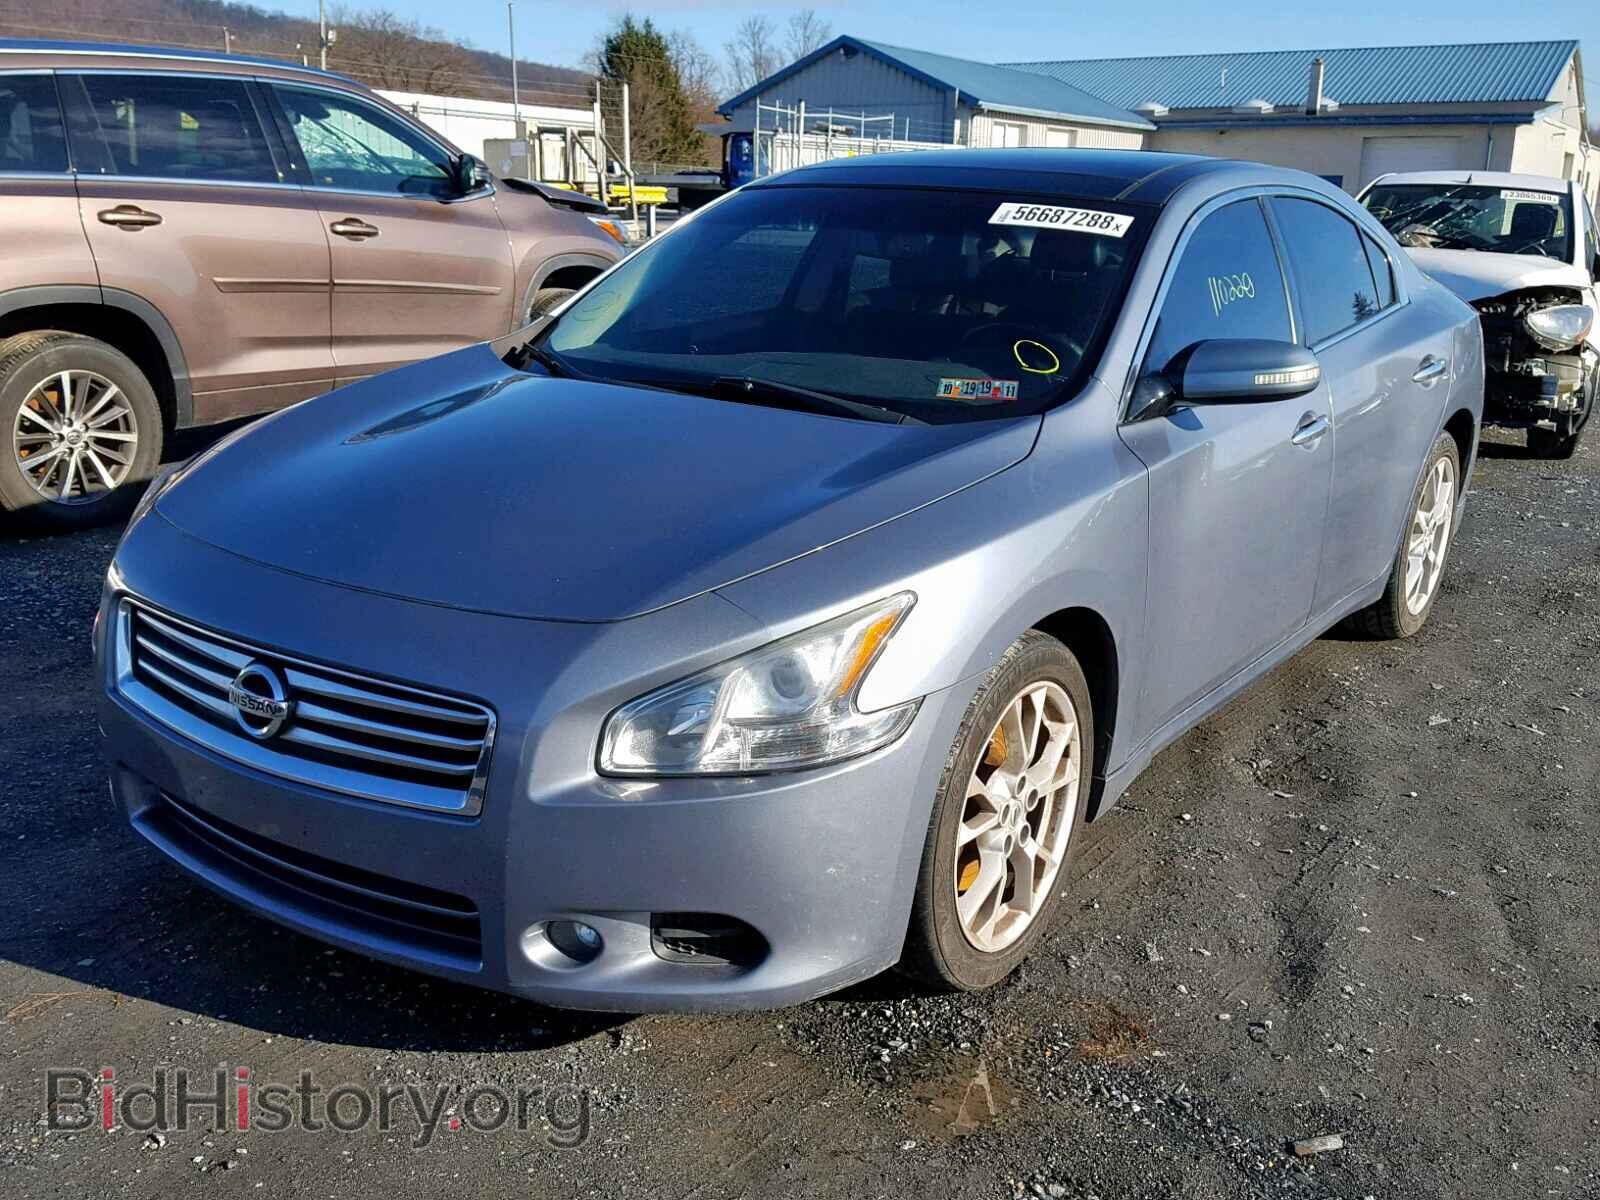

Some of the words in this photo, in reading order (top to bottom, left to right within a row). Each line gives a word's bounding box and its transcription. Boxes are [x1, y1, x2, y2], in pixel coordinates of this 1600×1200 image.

[1012, 205, 1115, 230] 56687288
[943, 382, 953, 395] 10
[964, 381, 977, 395] 19
[981, 380, 992, 394] 19
[1005, 384, 1016, 397] 11
[229, 687, 276, 715] NISSAN
